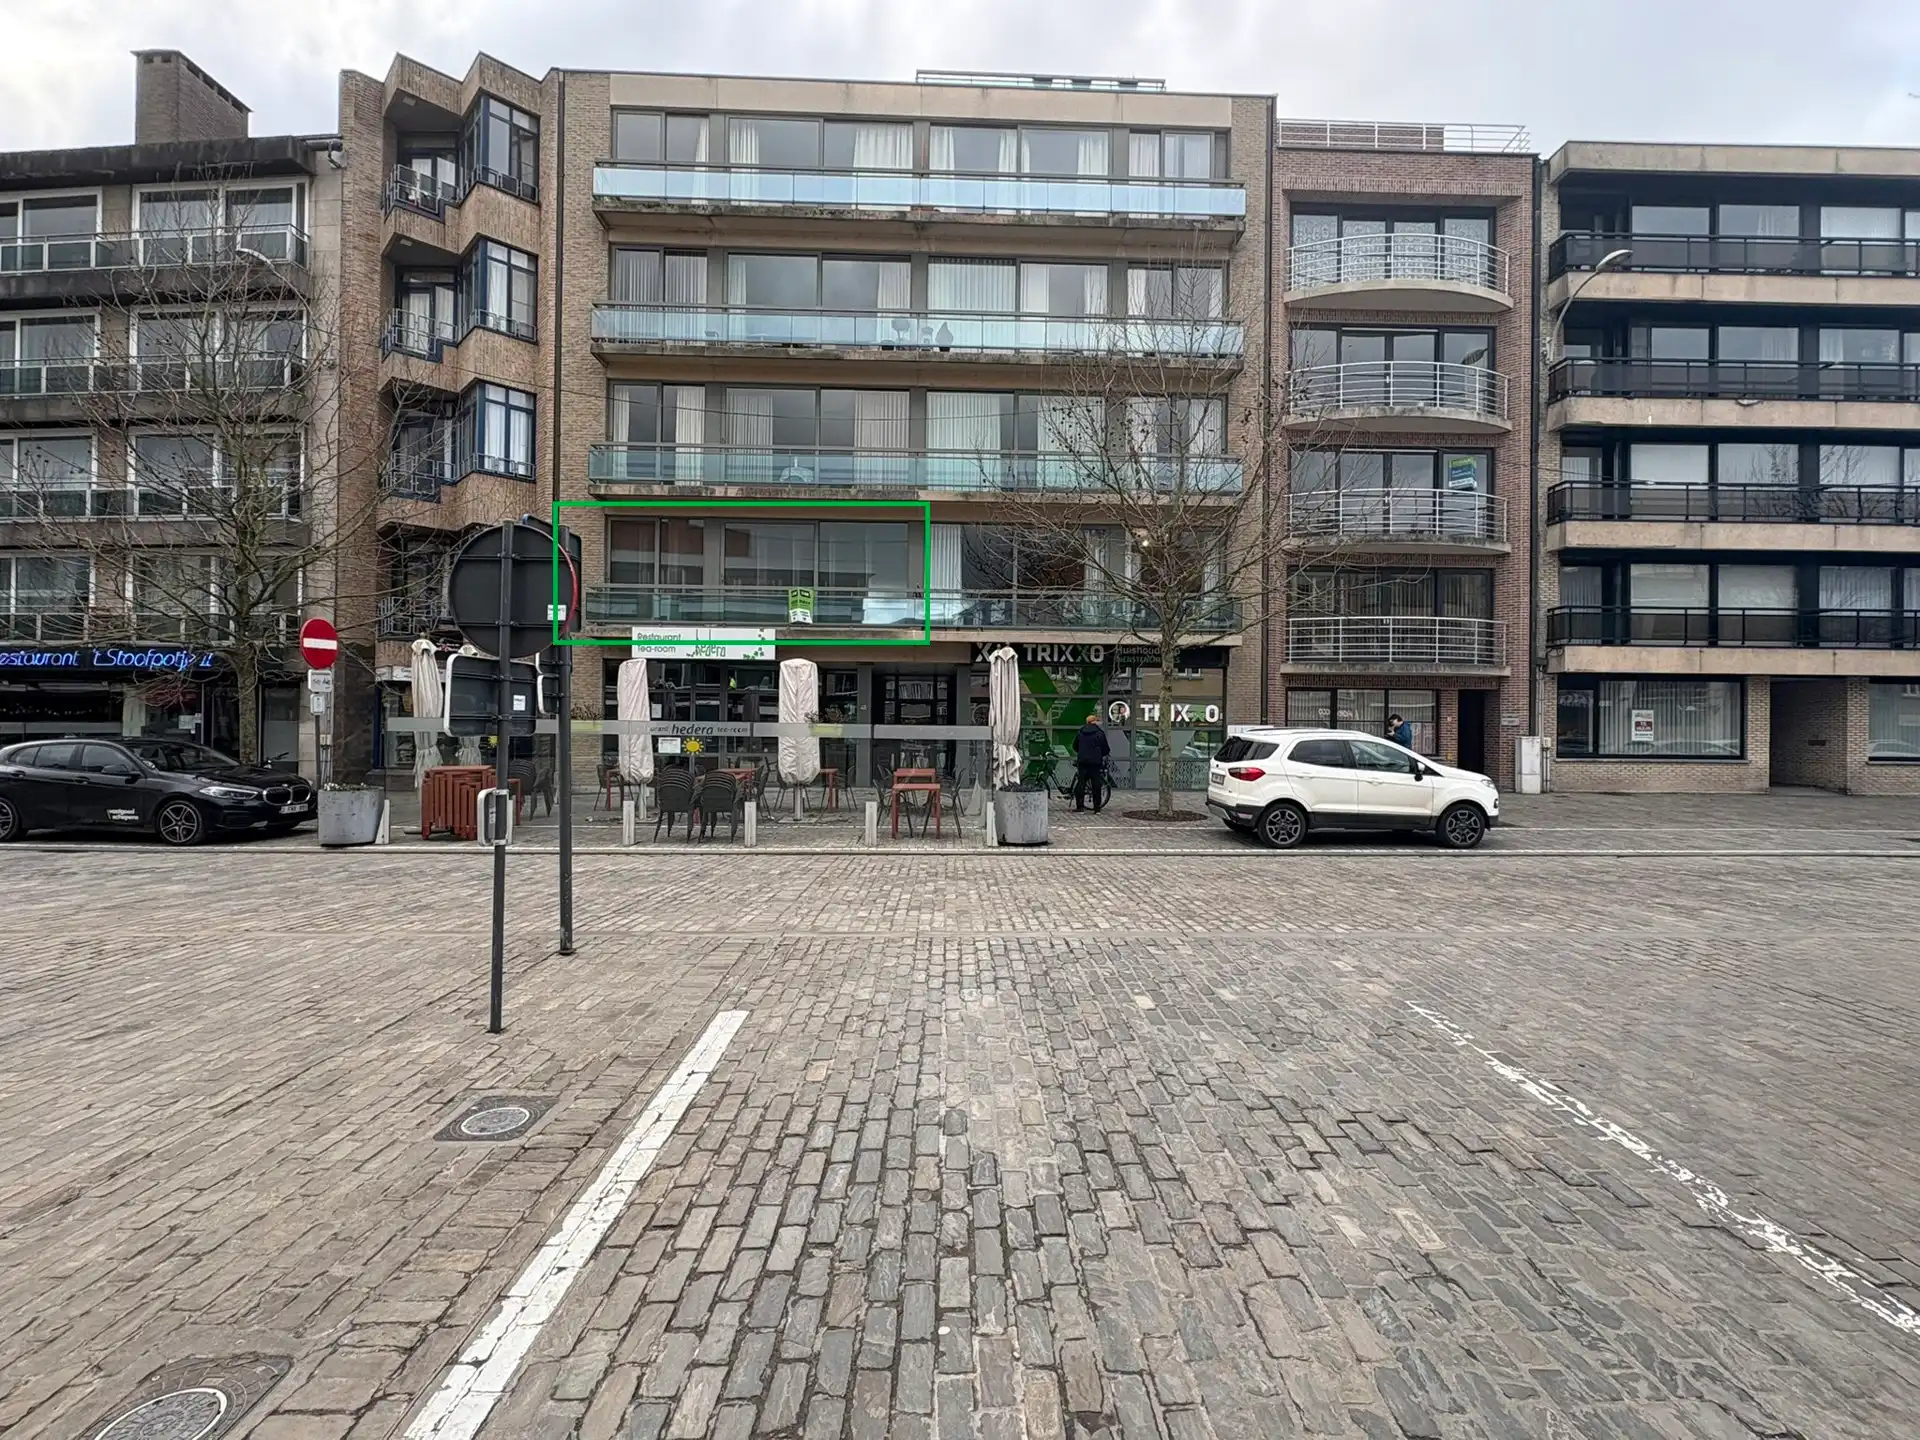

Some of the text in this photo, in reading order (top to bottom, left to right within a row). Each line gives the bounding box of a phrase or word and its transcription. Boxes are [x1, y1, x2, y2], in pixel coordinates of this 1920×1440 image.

[637, 632, 682, 642] Restaurant
[1023, 643, 1105, 663] TRIXXO
[671, 723, 714, 735] hedera
